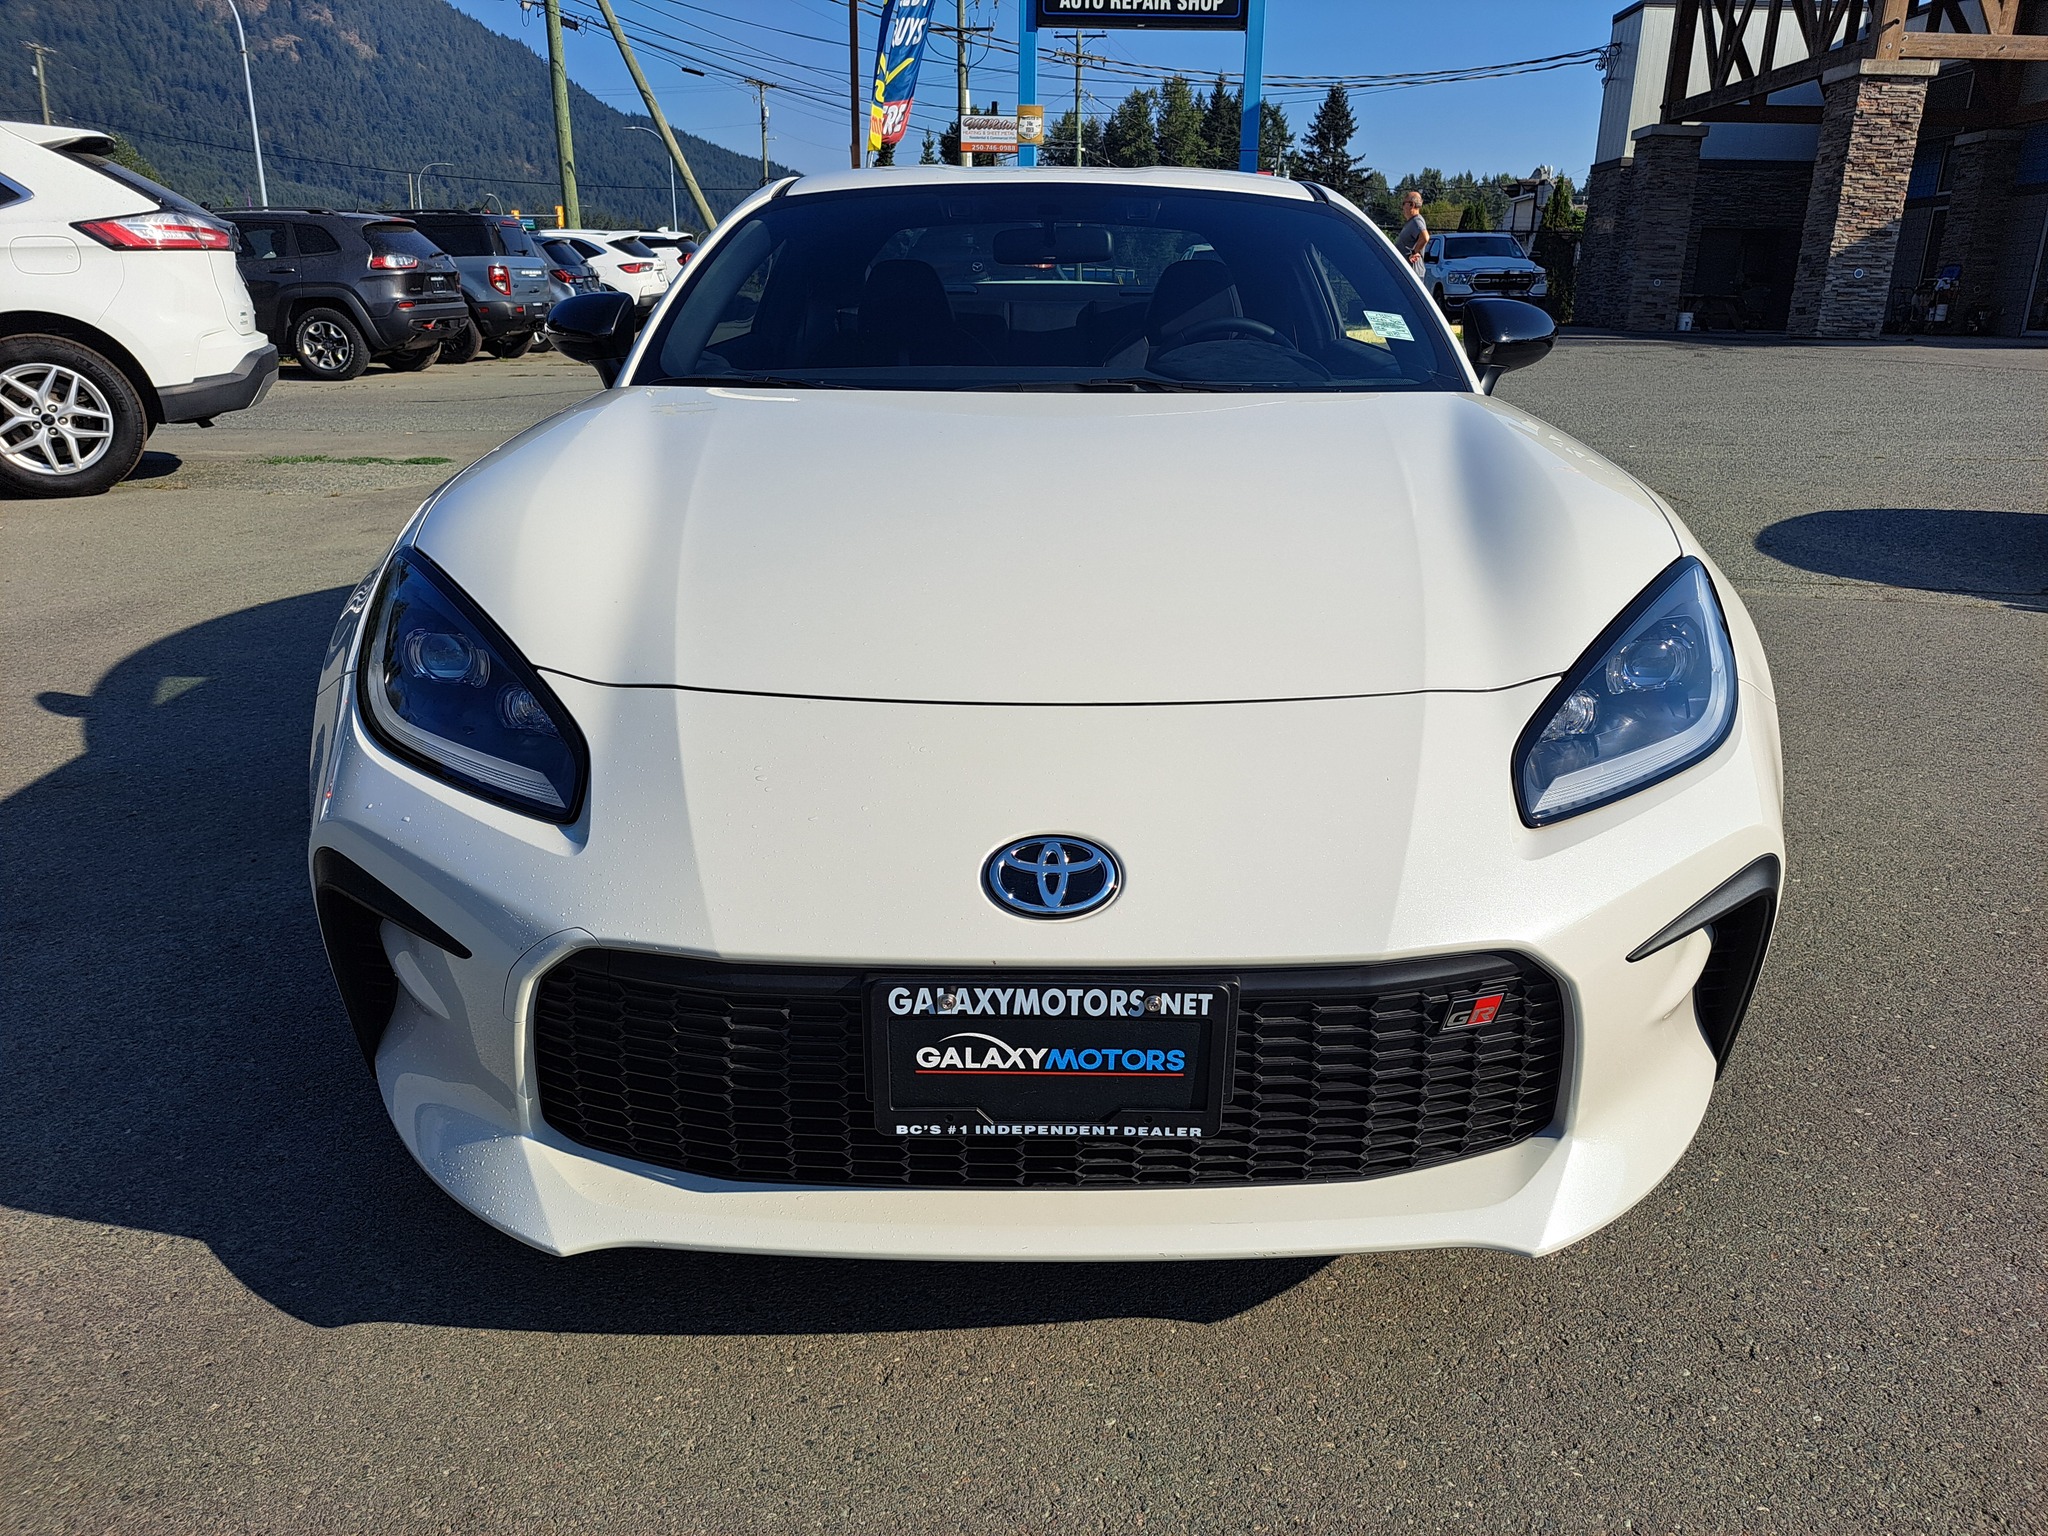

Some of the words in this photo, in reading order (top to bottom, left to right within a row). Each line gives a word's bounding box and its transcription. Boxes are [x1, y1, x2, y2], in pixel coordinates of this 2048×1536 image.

[1059, 0, 1104, 9] AUTO
[1110, 0, 1171, 10] REPAIR
[1177, 0, 1224, 12] SHOP
[891, 17, 928, 48] UYS
[1446, 1006, 1495, 1027] GR
[896, 1124, 941, 1135] BC'S
[947, 1124, 968, 1135] #1
[975, 1124, 1118, 1136] INDEPENDENT
[1123, 1126, 1203, 1138] DEALER
